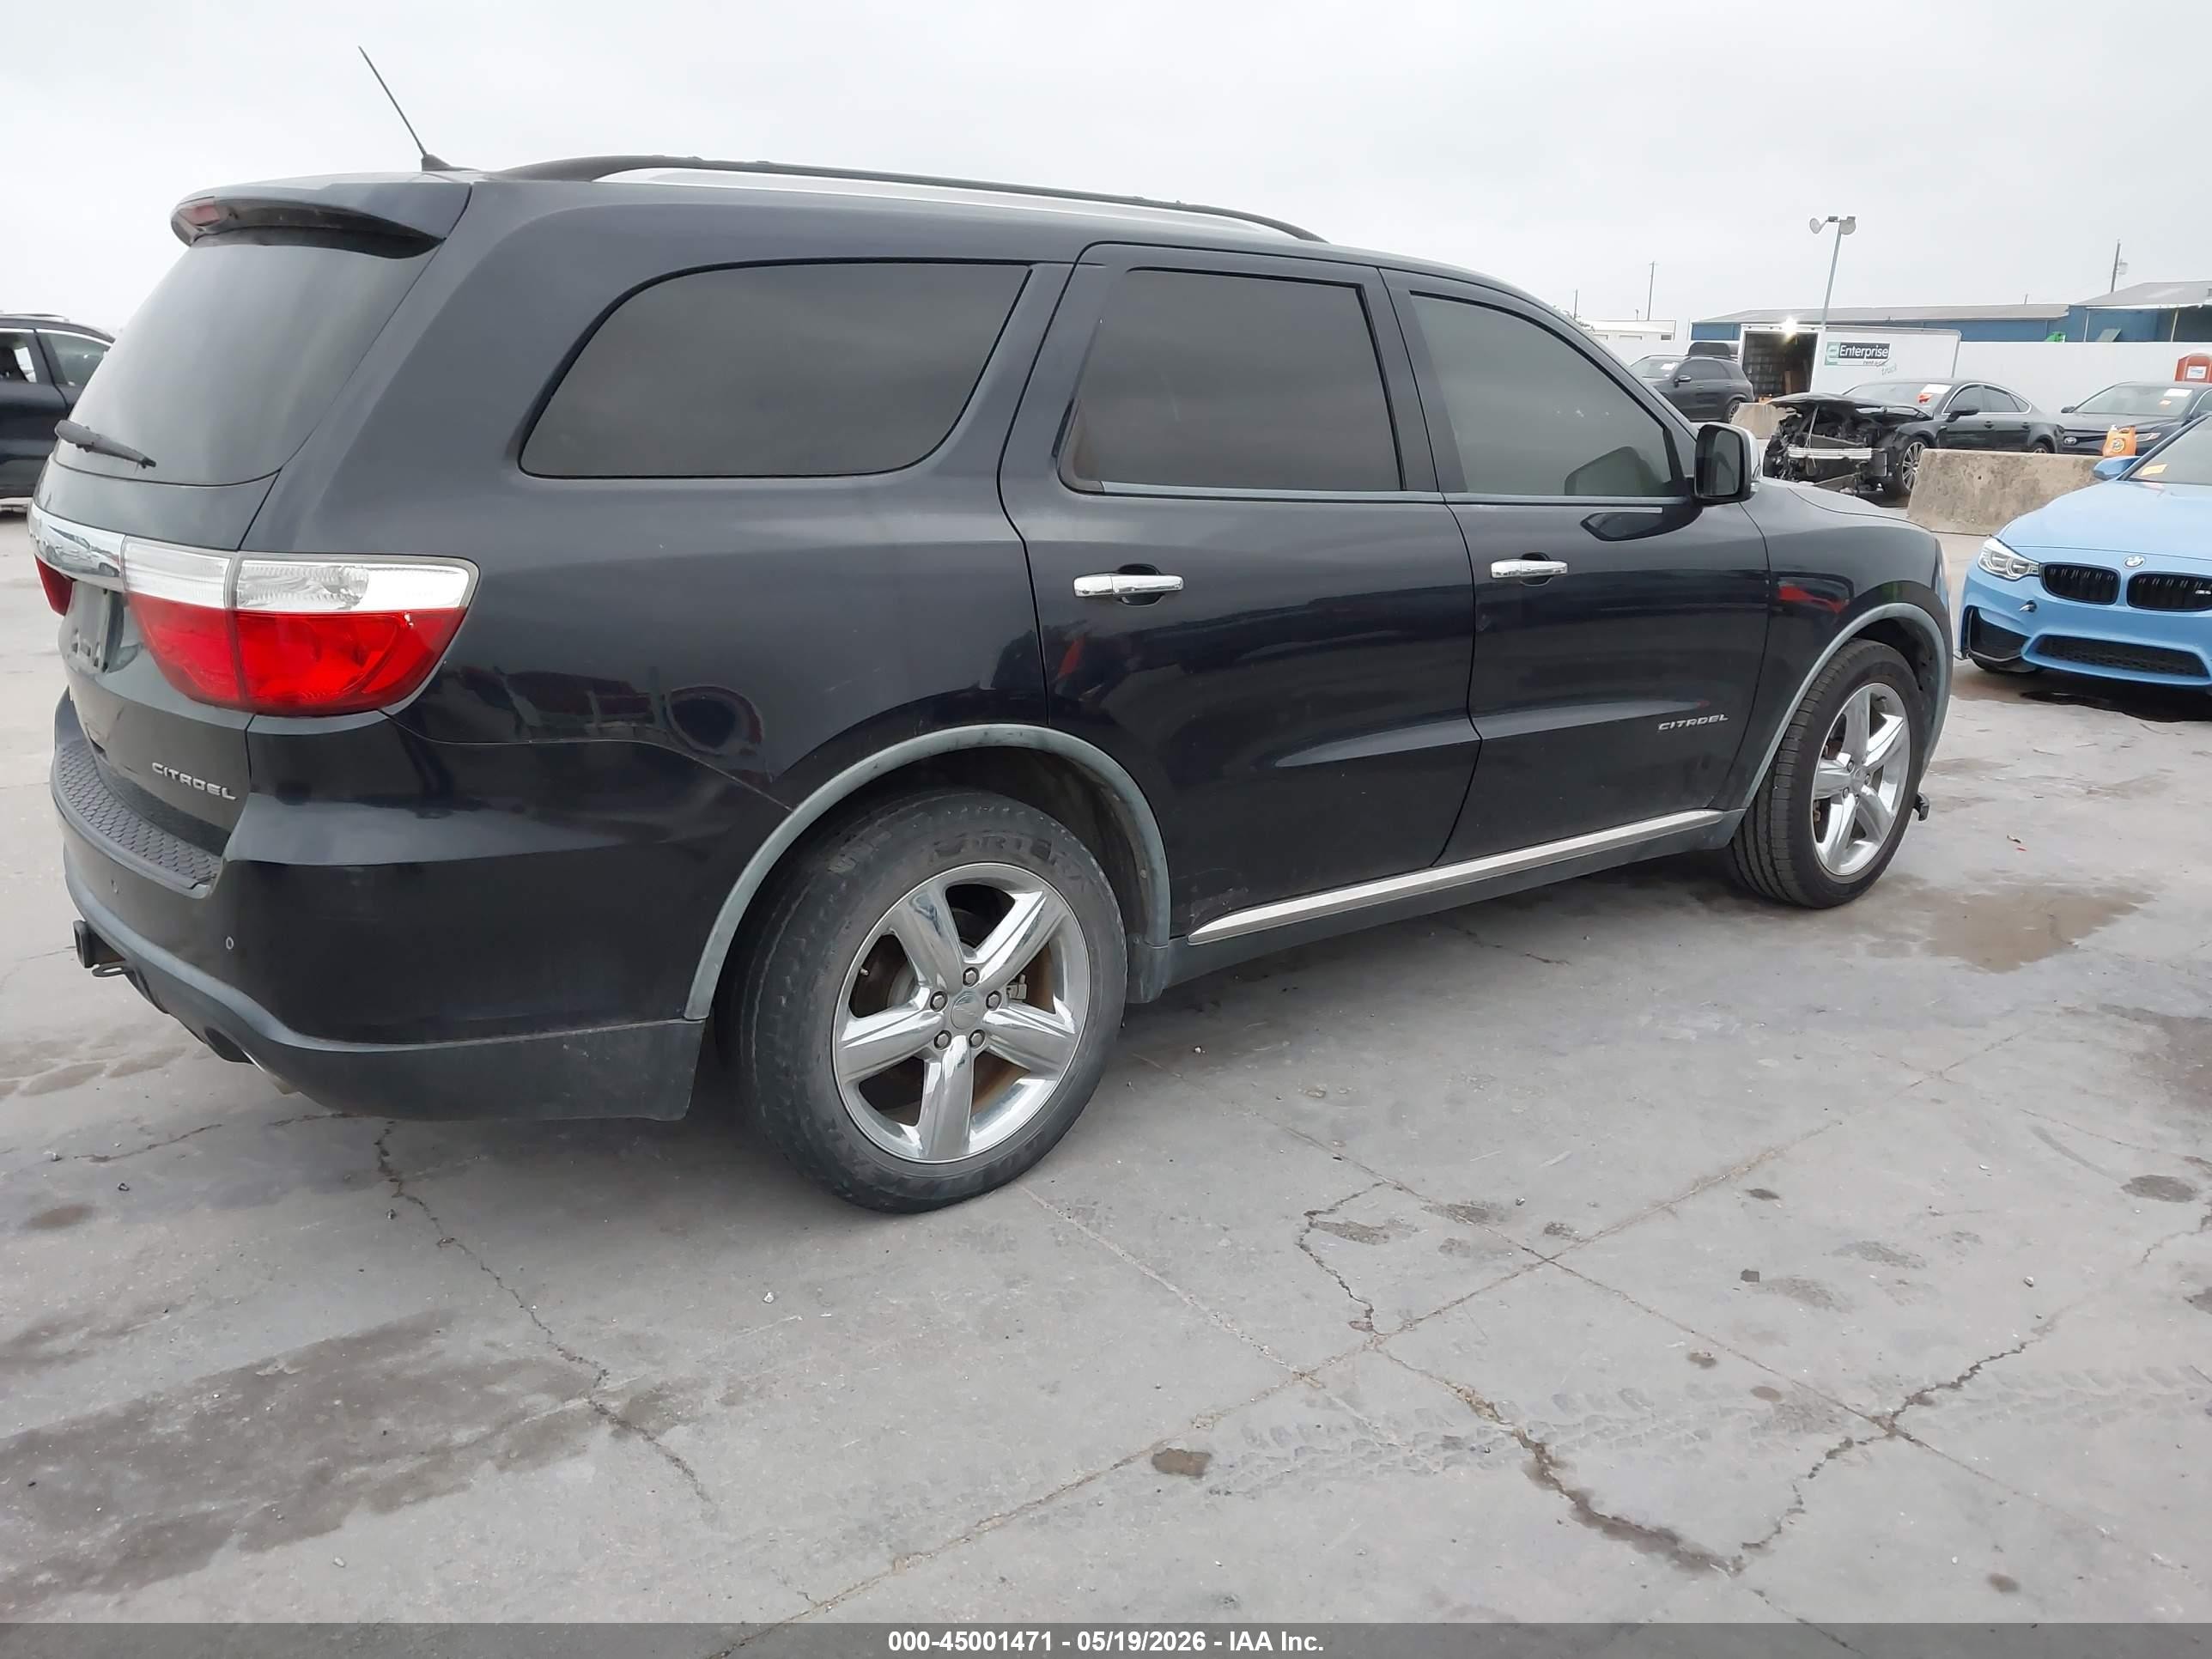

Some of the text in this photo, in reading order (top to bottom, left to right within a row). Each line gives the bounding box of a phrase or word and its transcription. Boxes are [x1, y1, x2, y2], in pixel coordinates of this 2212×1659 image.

[1839, 344, 1889, 360] Enterprise
[1657, 714, 1729, 731] CITADEL
[152, 762, 237, 800] CITADEL
